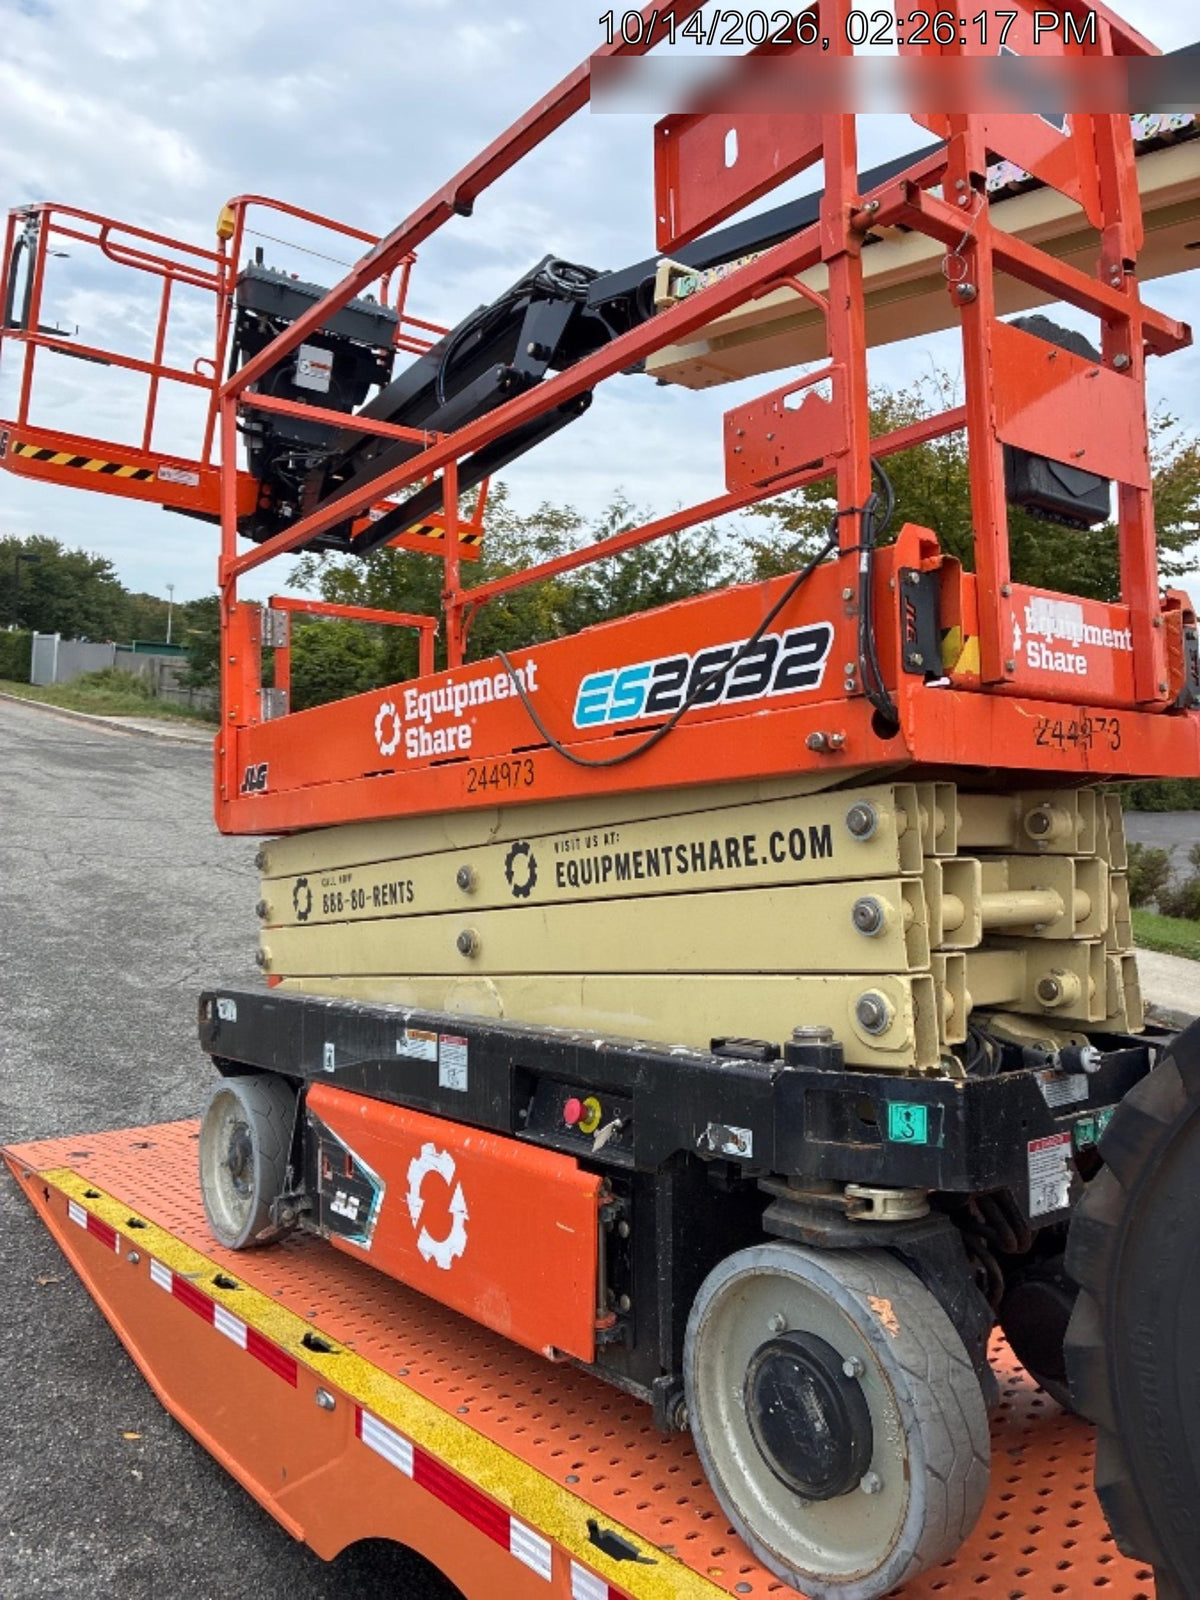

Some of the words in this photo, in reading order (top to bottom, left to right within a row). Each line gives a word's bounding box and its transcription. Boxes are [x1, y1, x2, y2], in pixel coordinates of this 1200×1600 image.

[572, 621, 834, 729] ES2632
[1025, 641, 1088, 676] Share
[403, 658, 539, 725] Equipment
[404, 724, 473, 760] Share
[1035, 717, 1121, 751] 244973
[466, 758, 535, 793] 244973
[554, 838, 580, 854] VISIT
[584, 834, 598, 849] US
[555, 824, 834, 889] EQUIPMENTSHARE.COM
[322, 879, 415, 915] 888-80-RENTS
